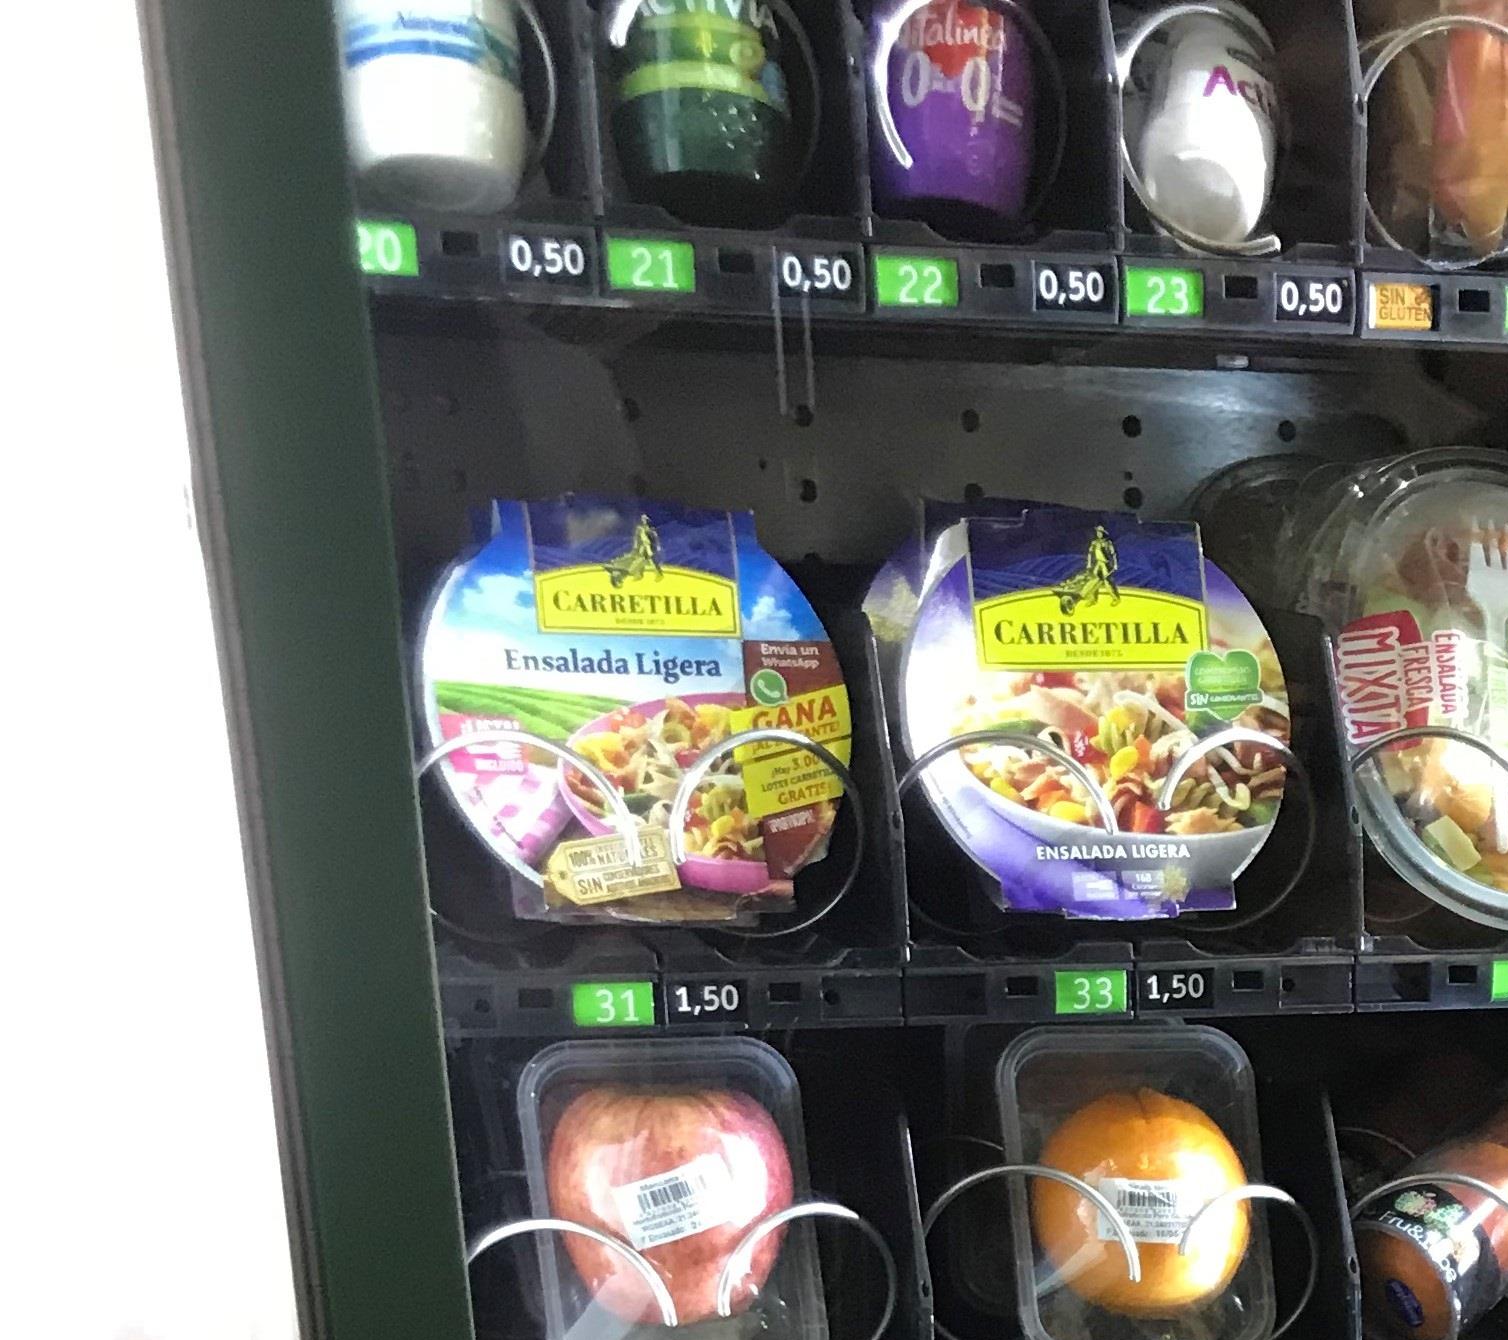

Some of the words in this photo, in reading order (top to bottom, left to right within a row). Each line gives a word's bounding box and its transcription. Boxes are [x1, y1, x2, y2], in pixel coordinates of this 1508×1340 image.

[511, 239, 585, 277] 0,50
[631, 247, 679, 288] 21
[782, 256, 851, 292] 0,50
[899, 266, 942, 303] 22
[1039, 270, 1104, 305] 0,50
[1147, 277, 1188, 314] 23
[1281, 281, 1342, 316] 0,50
[1379, 287, 1405, 304] SIN
[1379, 306, 1432, 321] GLUTEN
[553, 590, 722, 616] CARRETILLA
[800, 645, 819, 656] un
[995, 619, 1189, 647] CARRETILLA
[504, 648, 629, 677] Ensalada
[636, 651, 723, 683] Ligera
[1402, 641, 1432, 709] FRESCA
[1434, 631, 1461, 716] ENSALADA
[1190, 693, 1209, 705] SIN
[1340, 626, 1399, 744] MIXTA
[752, 694, 837, 731] GANA
[1036, 844, 1128, 861] ENSALADA
[1131, 843, 1191, 859] LIGERA
[577, 876, 604, 896] SIN
[596, 988, 639, 1023] 31
[676, 984, 740, 1016] 1,50
[1074, 976, 1112, 1009] 33
[1148, 973, 1205, 1003] 1,50
